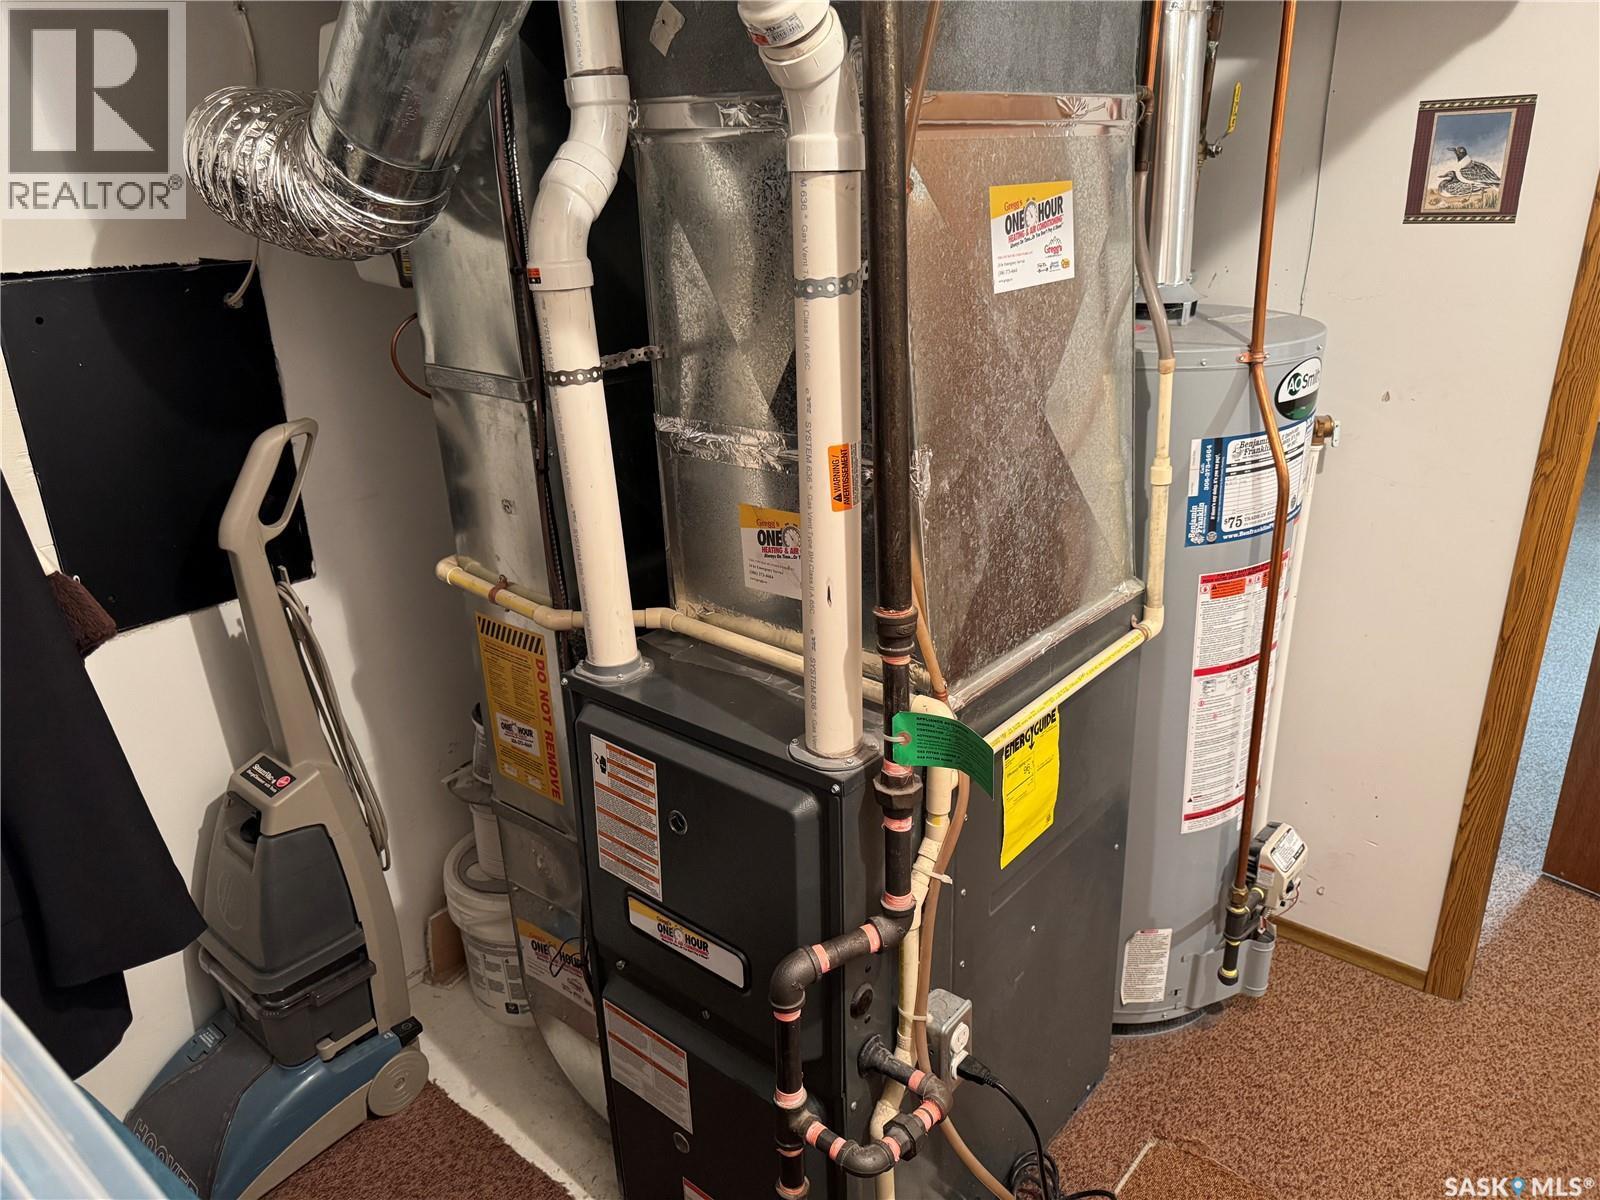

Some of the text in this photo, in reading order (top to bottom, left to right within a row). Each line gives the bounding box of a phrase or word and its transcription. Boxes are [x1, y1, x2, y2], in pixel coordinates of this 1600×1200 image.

[1005, 196, 1063, 235] ONE HOUR
[832, 459, 841, 493] WARNING
[841, 449, 850, 505] AVERTISSEMENT
[1189, 505, 1198, 538] Benjamin
[1196, 502, 1205, 533] Franklin
[1224, 515, 1242, 529] $75
[757, 529, 782, 546] ONE
[535, 659, 561, 800] DO NOT REMOVE
[532, 940, 549, 954] ONE
[657, 923, 673, 937] ONE
[685, 934, 708, 952] HOUR
